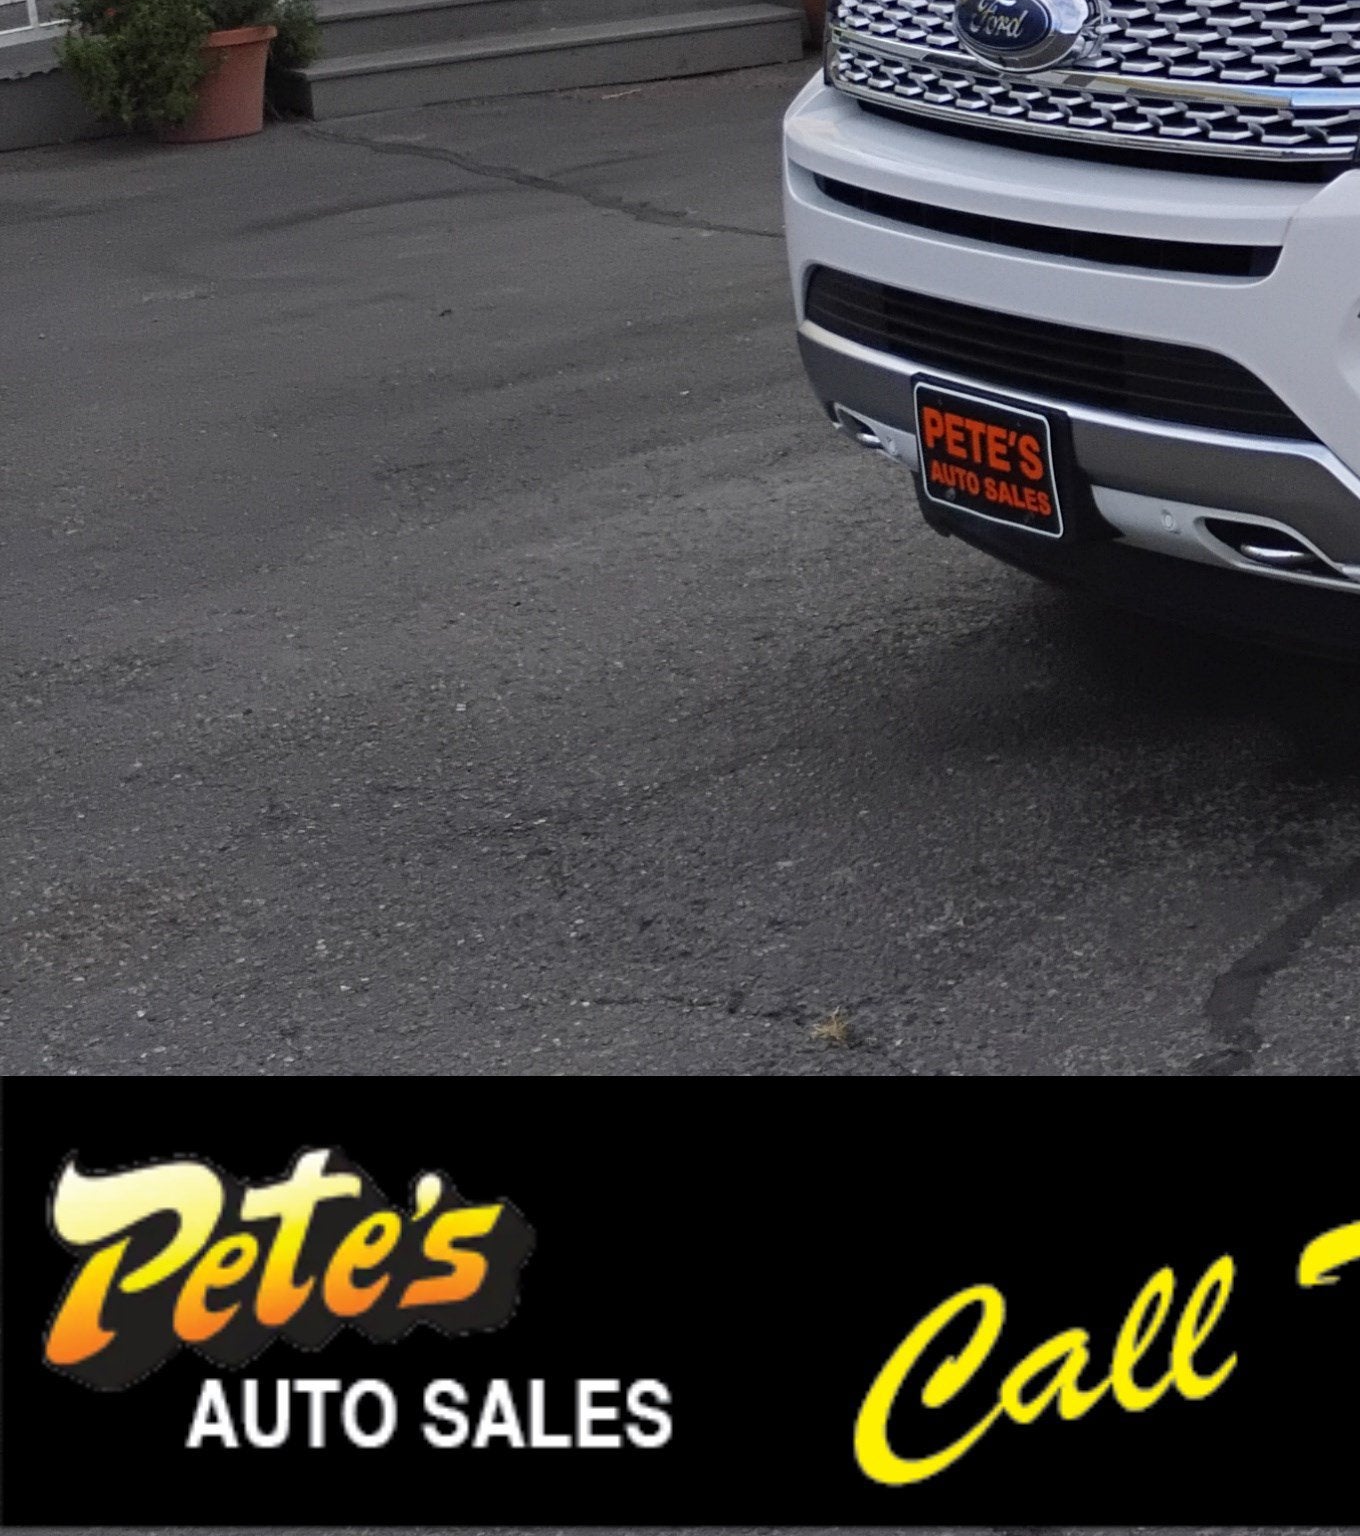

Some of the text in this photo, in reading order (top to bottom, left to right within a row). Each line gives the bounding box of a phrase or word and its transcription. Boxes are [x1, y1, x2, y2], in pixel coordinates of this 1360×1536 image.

[922, 406, 1044, 481] PETE'S
[931, 460, 1052, 517] AUTO SALES
